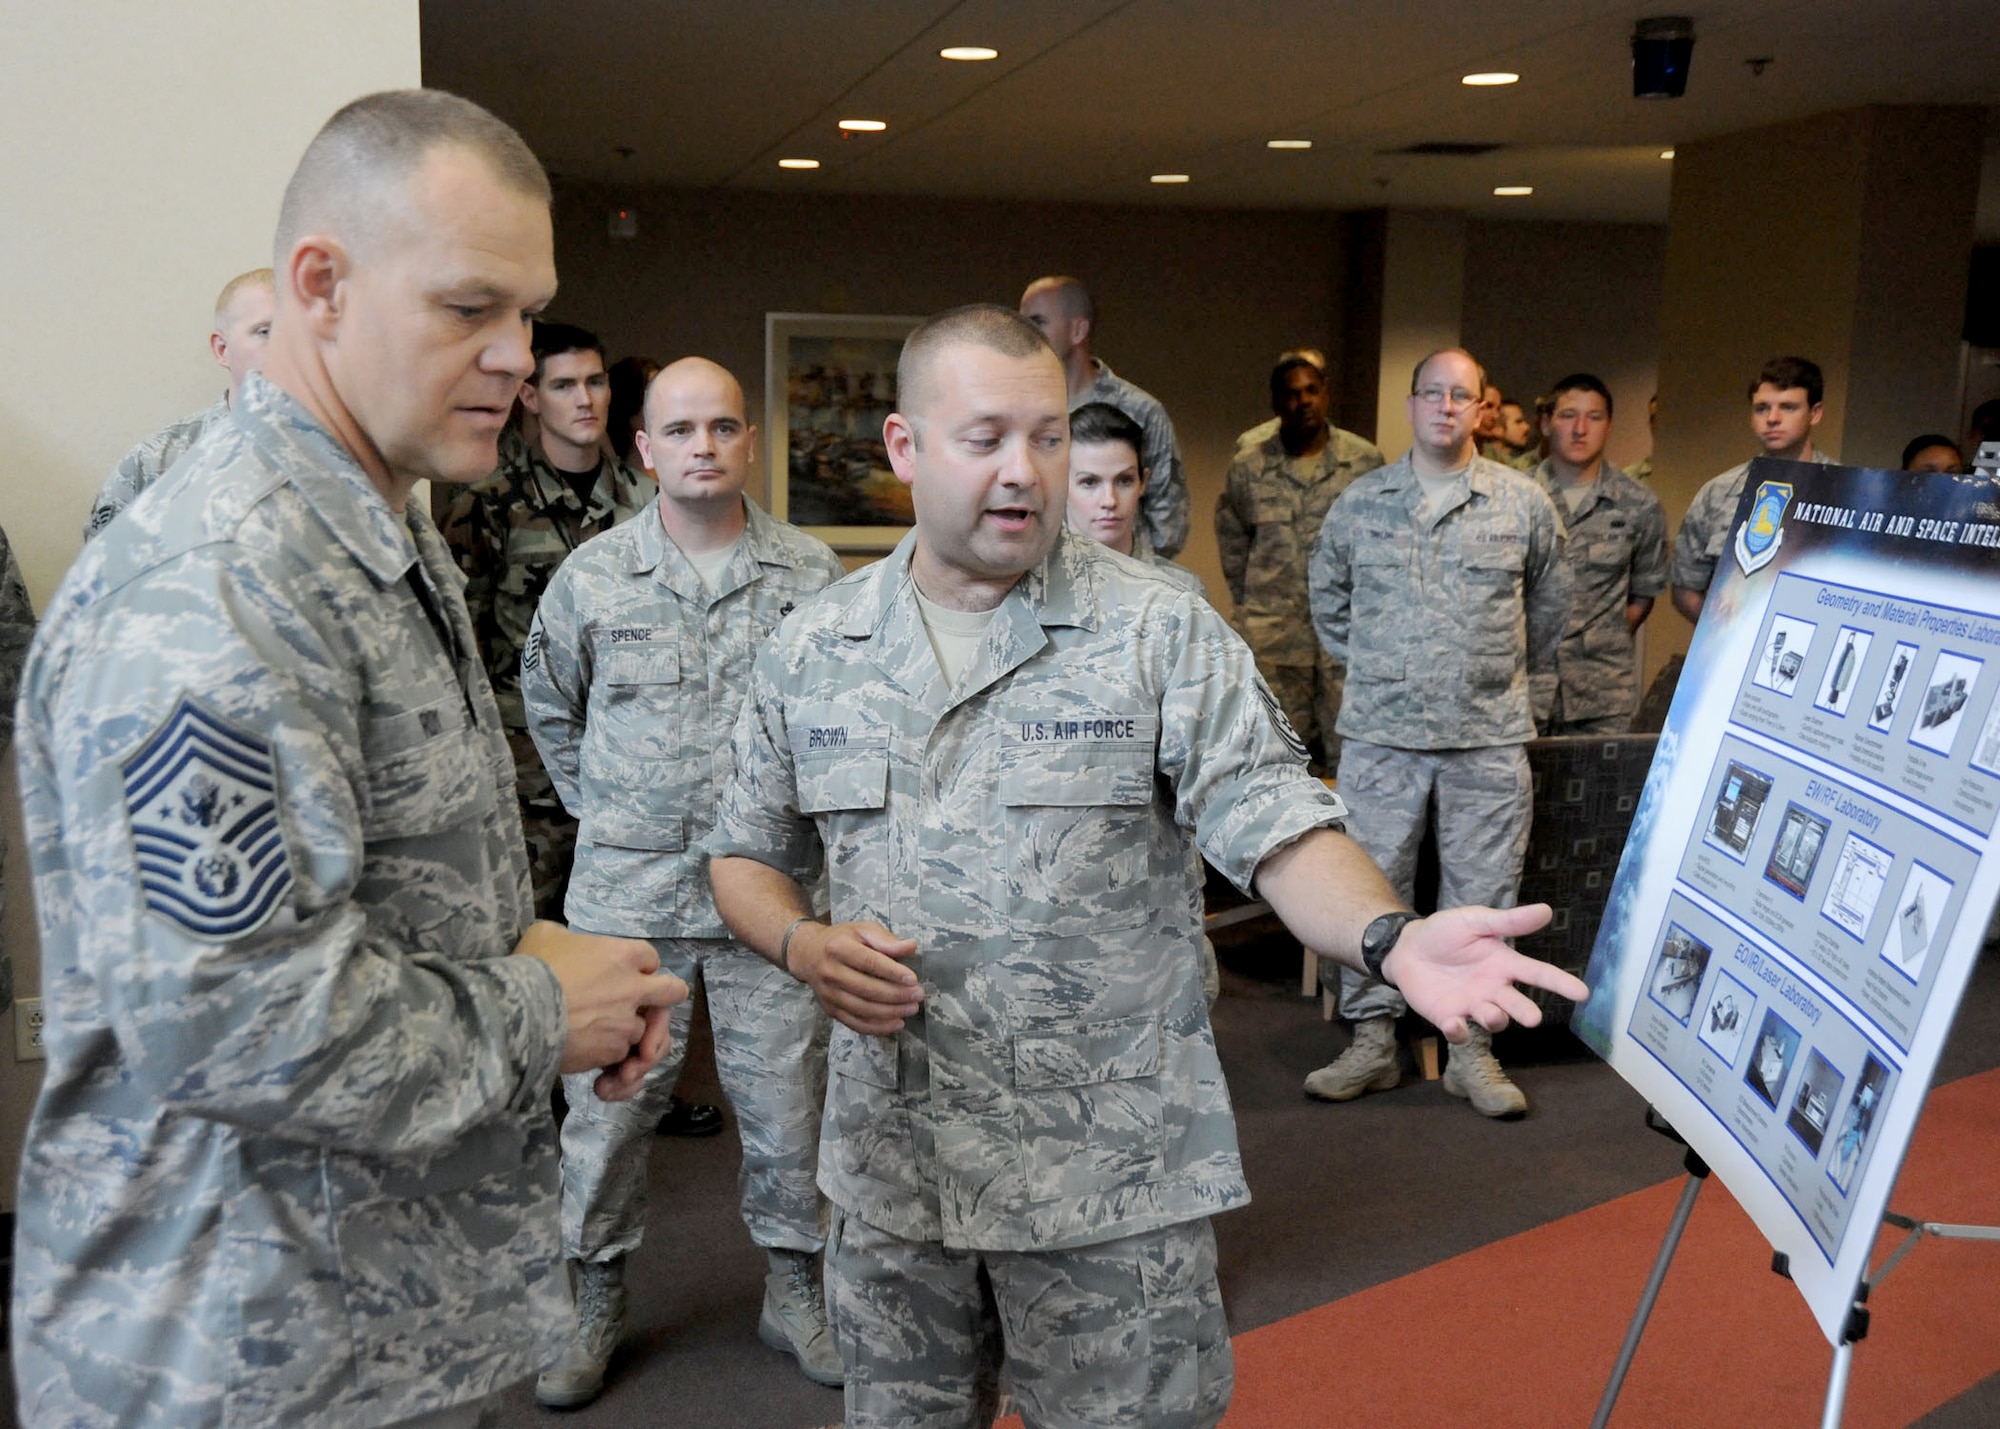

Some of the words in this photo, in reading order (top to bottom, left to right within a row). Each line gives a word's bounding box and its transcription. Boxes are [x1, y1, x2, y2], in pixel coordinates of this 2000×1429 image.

[1793, 502, 1857, 529] NATIONAL
[1858, 511, 1884, 532] AIR
[1885, 515, 1915, 536] AND
[1915, 519, 1960, 543] SPACE
[1816, 588, 1862, 617] Geometry
[1862, 600, 1882, 618] and
[1881, 602, 1920, 627] Material
[1919, 610, 1969, 638] Properties
[611, 629, 651, 643] SPENCE
[809, 726, 848, 747] BROWN
[1022, 723, 1048, 741] U.S.
[1054, 721, 1078, 739] AIR
[1084, 719, 1134, 738] FORCE
[1805, 780, 1838, 806] EW/RF
[1834, 794, 1882, 834] Laboratory
[1734, 942, 1782, 989] EO/IR/Laser
[1779, 977, 1823, 1027] Laboratory
